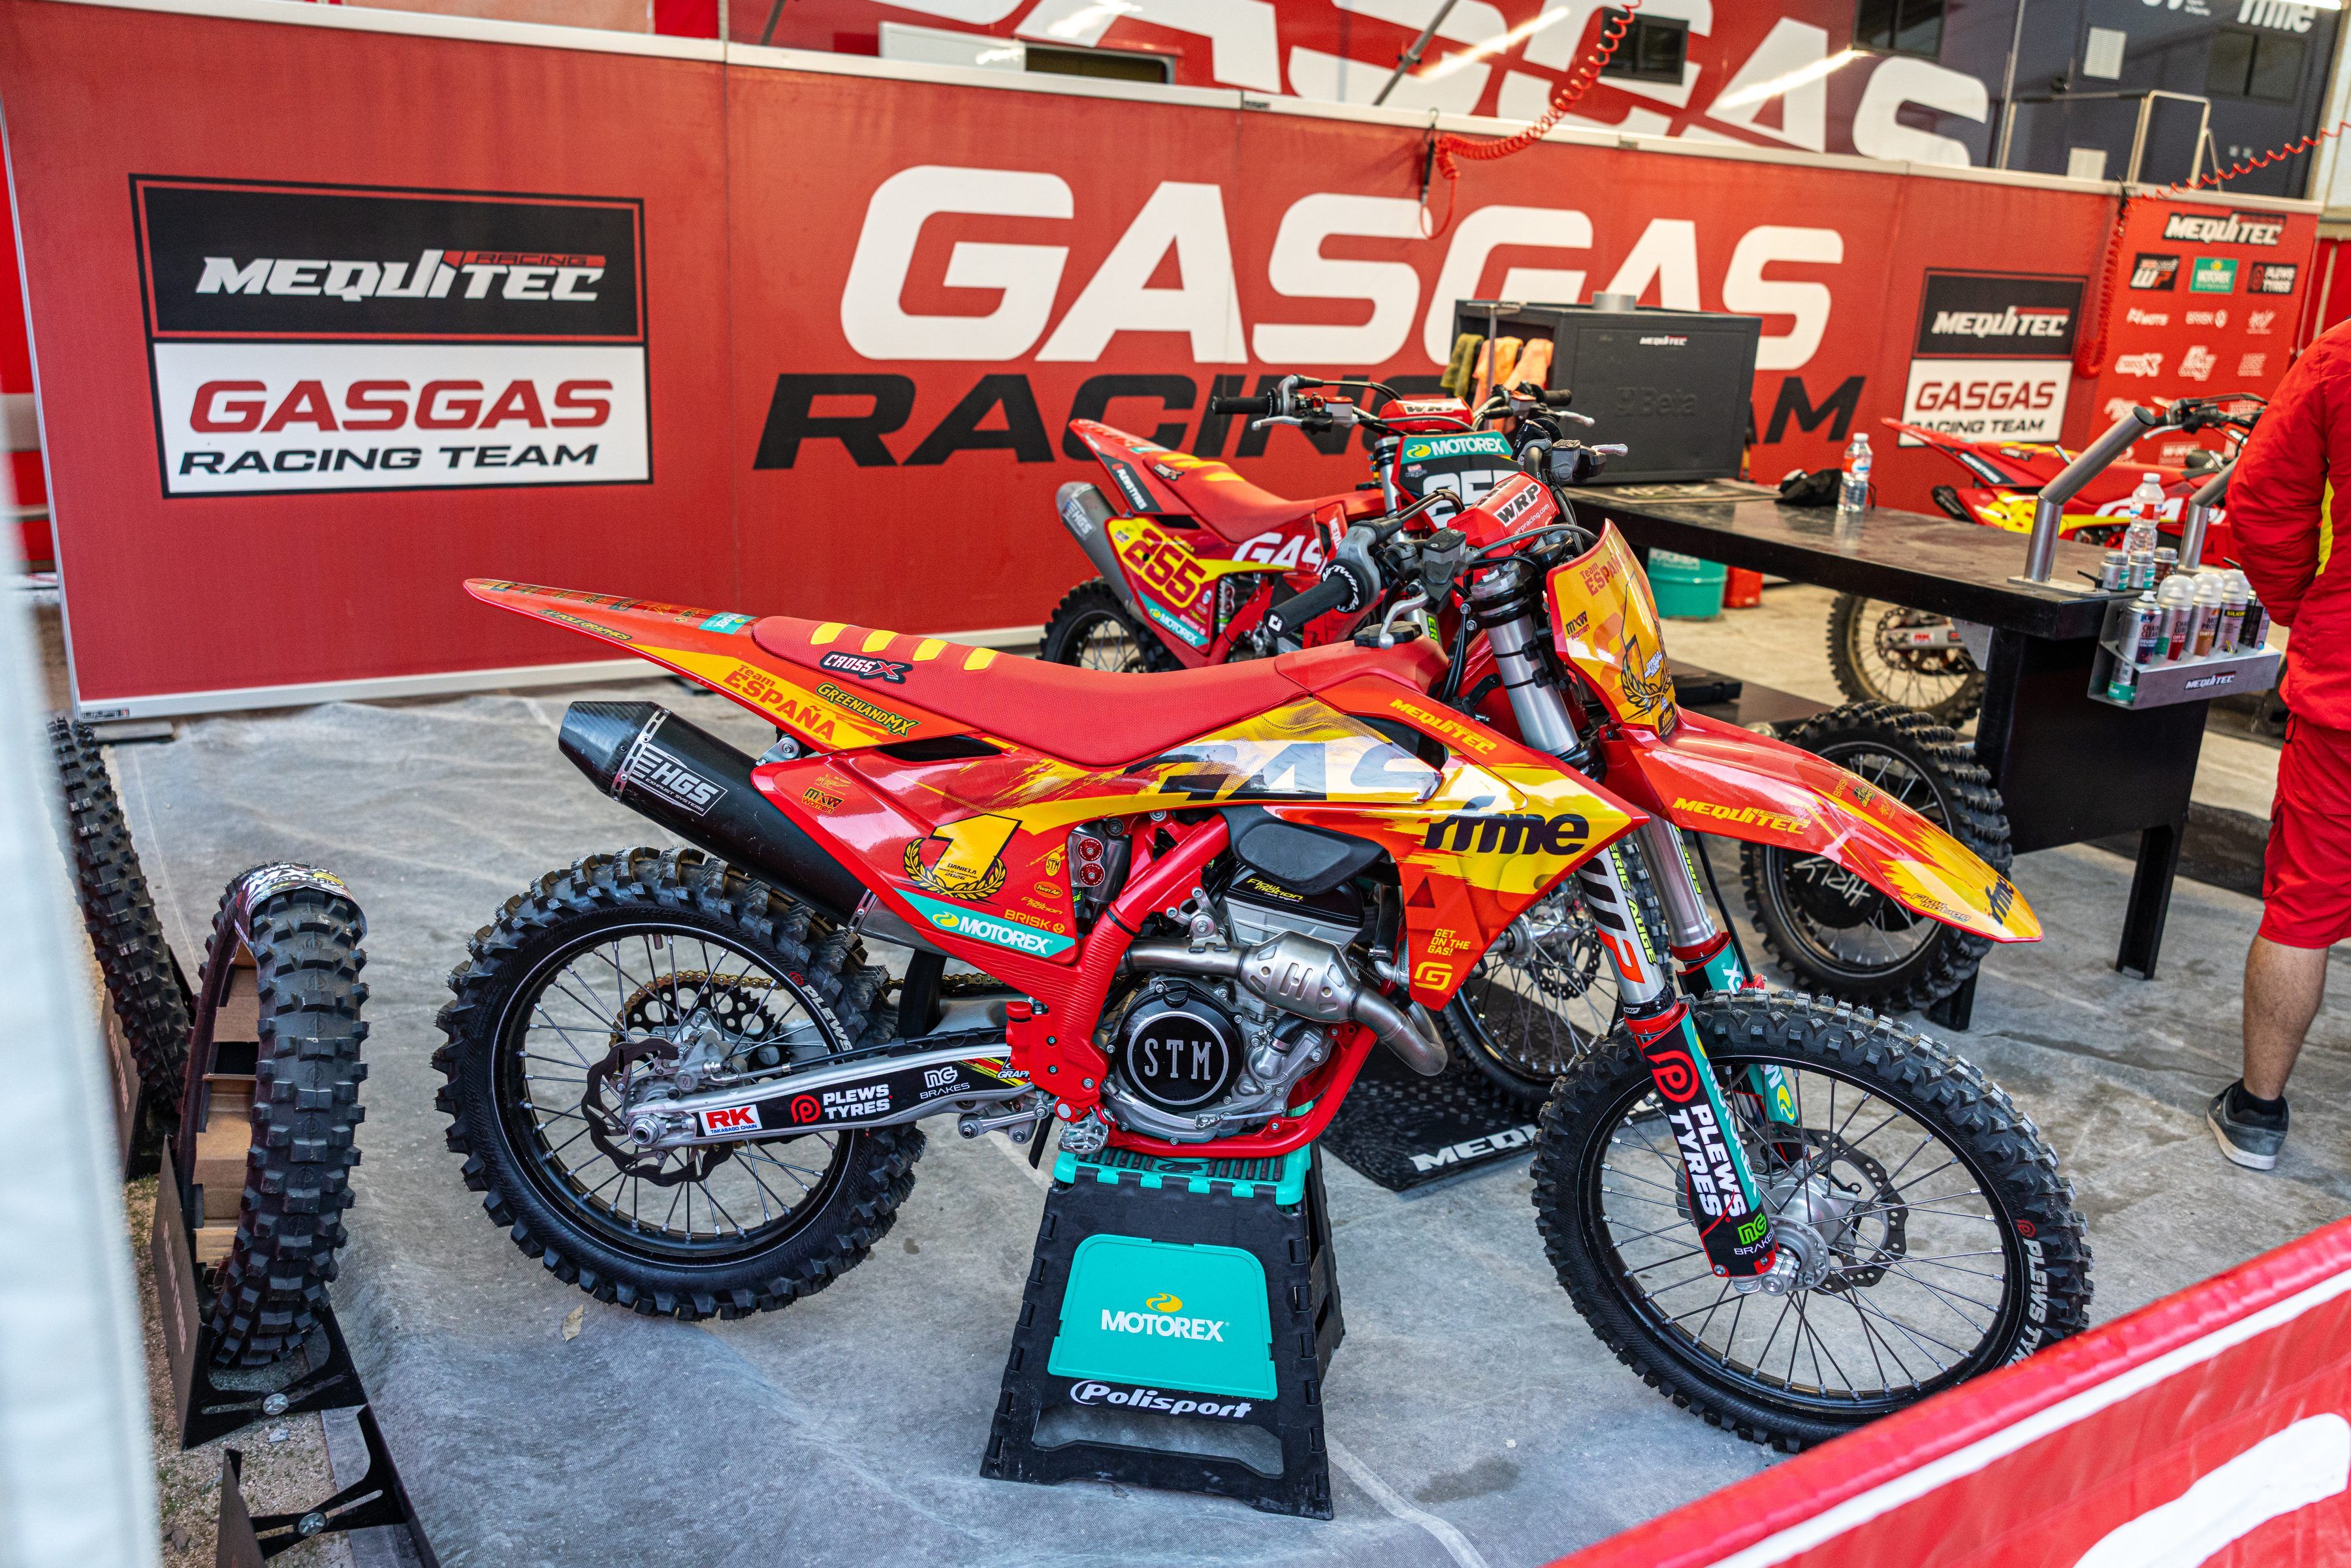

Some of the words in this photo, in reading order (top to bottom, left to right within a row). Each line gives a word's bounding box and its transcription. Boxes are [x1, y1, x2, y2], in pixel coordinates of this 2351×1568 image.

[2163, 212, 2284, 246] MEQUITEC
[196, 249, 605, 302] MEQUITEC
[840, 165, 1844, 370] GASGAS
[1931, 306, 2070, 338] MEQUITEC
[189, 379, 613, 433] GASGAS
[1915, 381, 2057, 411] GASGAS
[1991, 419, 2044, 432] TEAM
[179, 447, 421, 475] RACING
[439, 443, 599, 470] TEAM
[1430, 437, 1505, 456] MOTOREX
[1495, 483, 1541, 525] WRP
[1514, 504, 1550, 536] wrpracing.com
[1580, 562, 1599, 580] Team
[581, 620, 632, 641] GRAPHICS
[1159, 613, 1198, 645] MOTOREX
[737, 664, 776, 687] Team
[2184, 673, 2236, 690] MEQUITEC
[723, 671, 836, 742] ESPAÑA
[817, 682, 920, 736] GREENLANDMX
[1389, 698, 1497, 755] MEQUITEC
[645, 777, 675, 796] EXHAUST
[675, 793, 705, 812] SYSTEMS
[650, 762, 719, 805] HGS
[1832, 777, 1849, 797] BRISK
[804, 787, 844, 808] MXW
[1672, 797, 1811, 835] MEQUITEC
[947, 863, 977, 874] DANIELA
[1046, 859, 1061, 871] STM
[1036, 884, 1051, 893] Twin
[1247, 878, 1281, 890] Flow
[1255, 886, 1303, 900] motion
[1021, 897, 1046, 906] Flow
[1027, 903, 1063, 915] motion
[1910, 893, 1948, 908] Flow
[1920, 901, 1971, 921] motion
[1004, 909, 1050, 930] BRISK
[959, 916, 1048, 954] MOTOREX
[1431, 936, 1450, 946] ON
[1450, 939, 1471, 950] THE
[1434, 928, 1456, 938] GET
[1427, 944, 1454, 956] GAS!
[801, 984, 854, 1051] PLEWS
[1144, 1037, 1211, 1081] STM
[823, 1084, 889, 1106] PLEWS
[920, 1082, 970, 1099] BRAKES
[706, 1107, 756, 1128] RK
[824, 1098, 891, 1121] TYRES
[1669, 1109, 1723, 1217] TYRES
[1690, 1104, 1747, 1217] PLEWS
[1734, 1227, 1774, 1255] BRAKES
[2023, 1238, 2049, 1324] PLEWS
[1101, 1309, 1224, 1343] MOTOREX
[1072, 1380, 1252, 1418] Polisport
